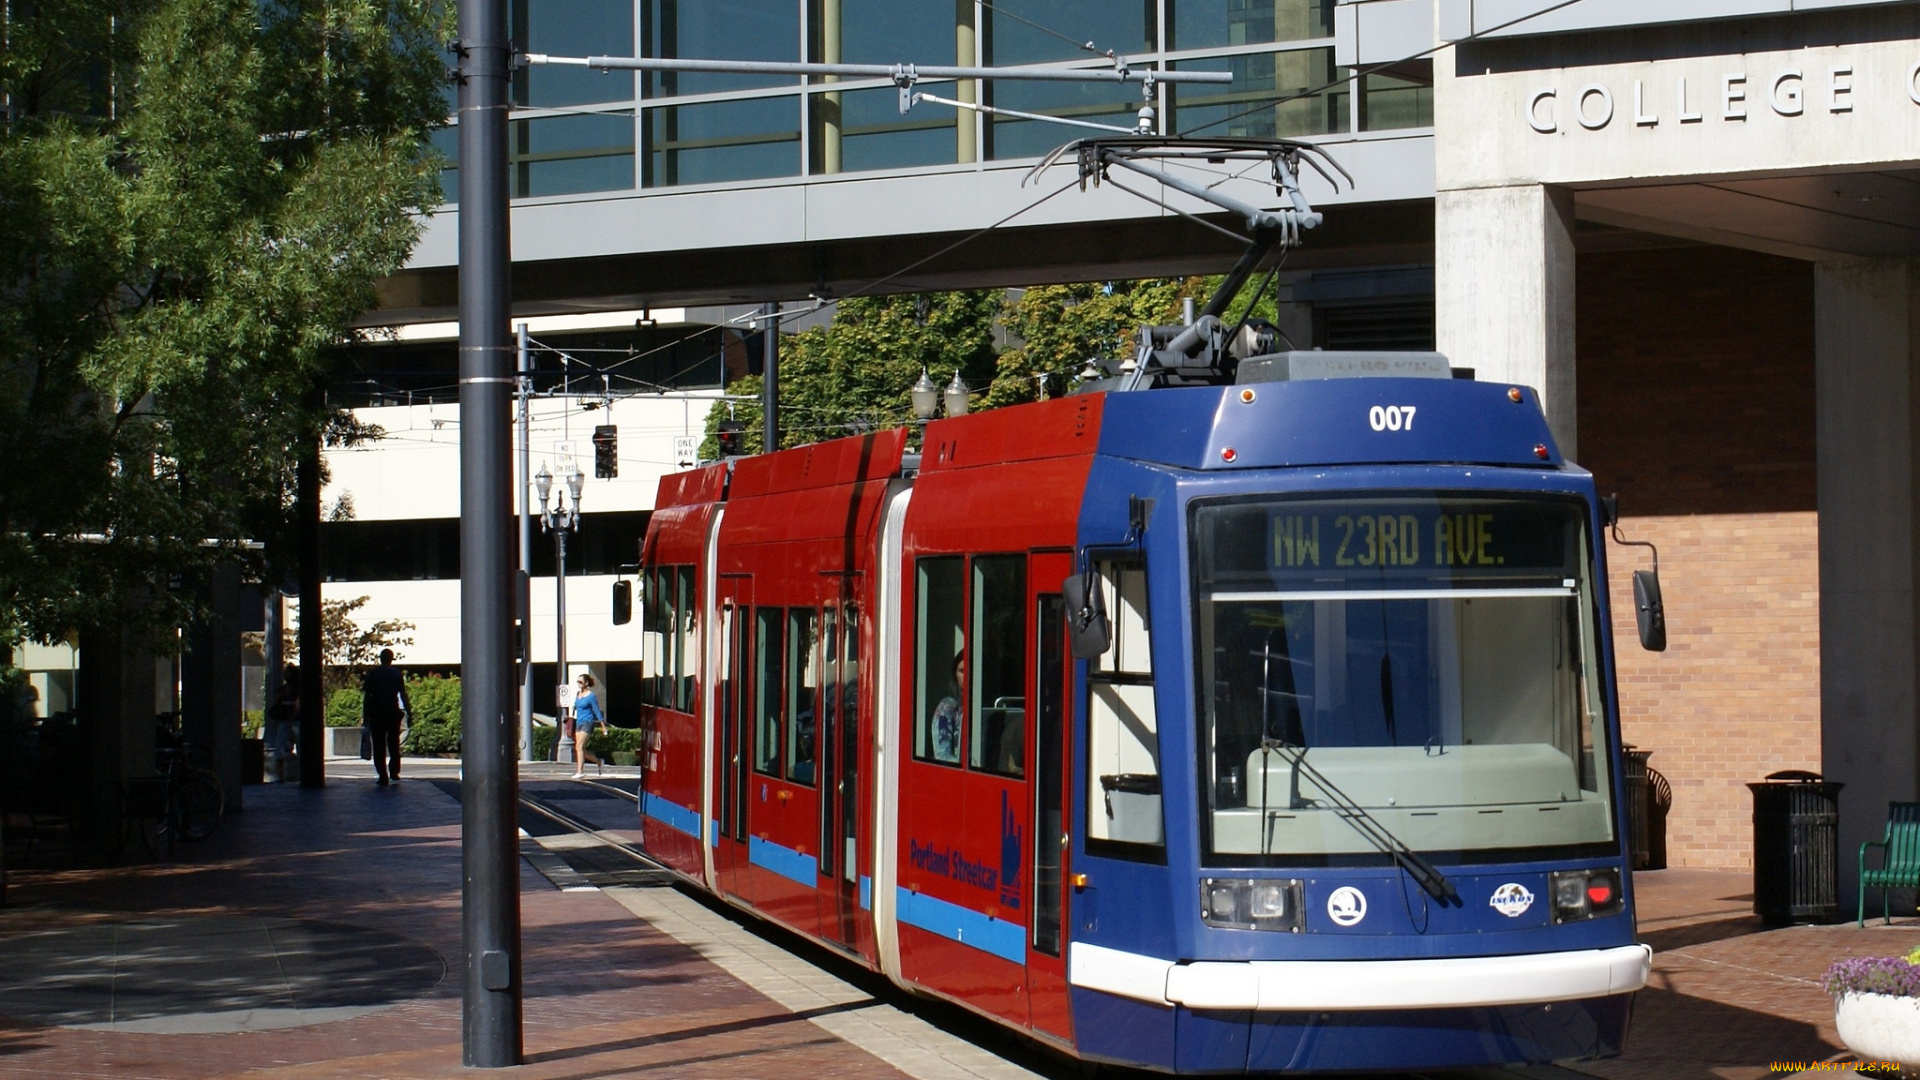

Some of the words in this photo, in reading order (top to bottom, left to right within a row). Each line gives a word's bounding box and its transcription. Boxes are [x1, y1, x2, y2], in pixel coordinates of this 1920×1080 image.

[1525, 64, 1853, 134] COLLEGE
[1369, 405, 1417, 432] 007
[677, 438, 693, 448] ONE
[677, 448, 694, 458] WAY
[1273, 516, 1320, 567] NW
[1335, 515, 1419, 566] 23RD
[1435, 514, 1505, 565] AVE.
[910, 838, 949, 877] Portland
[952, 850, 998, 891] Streetcar
